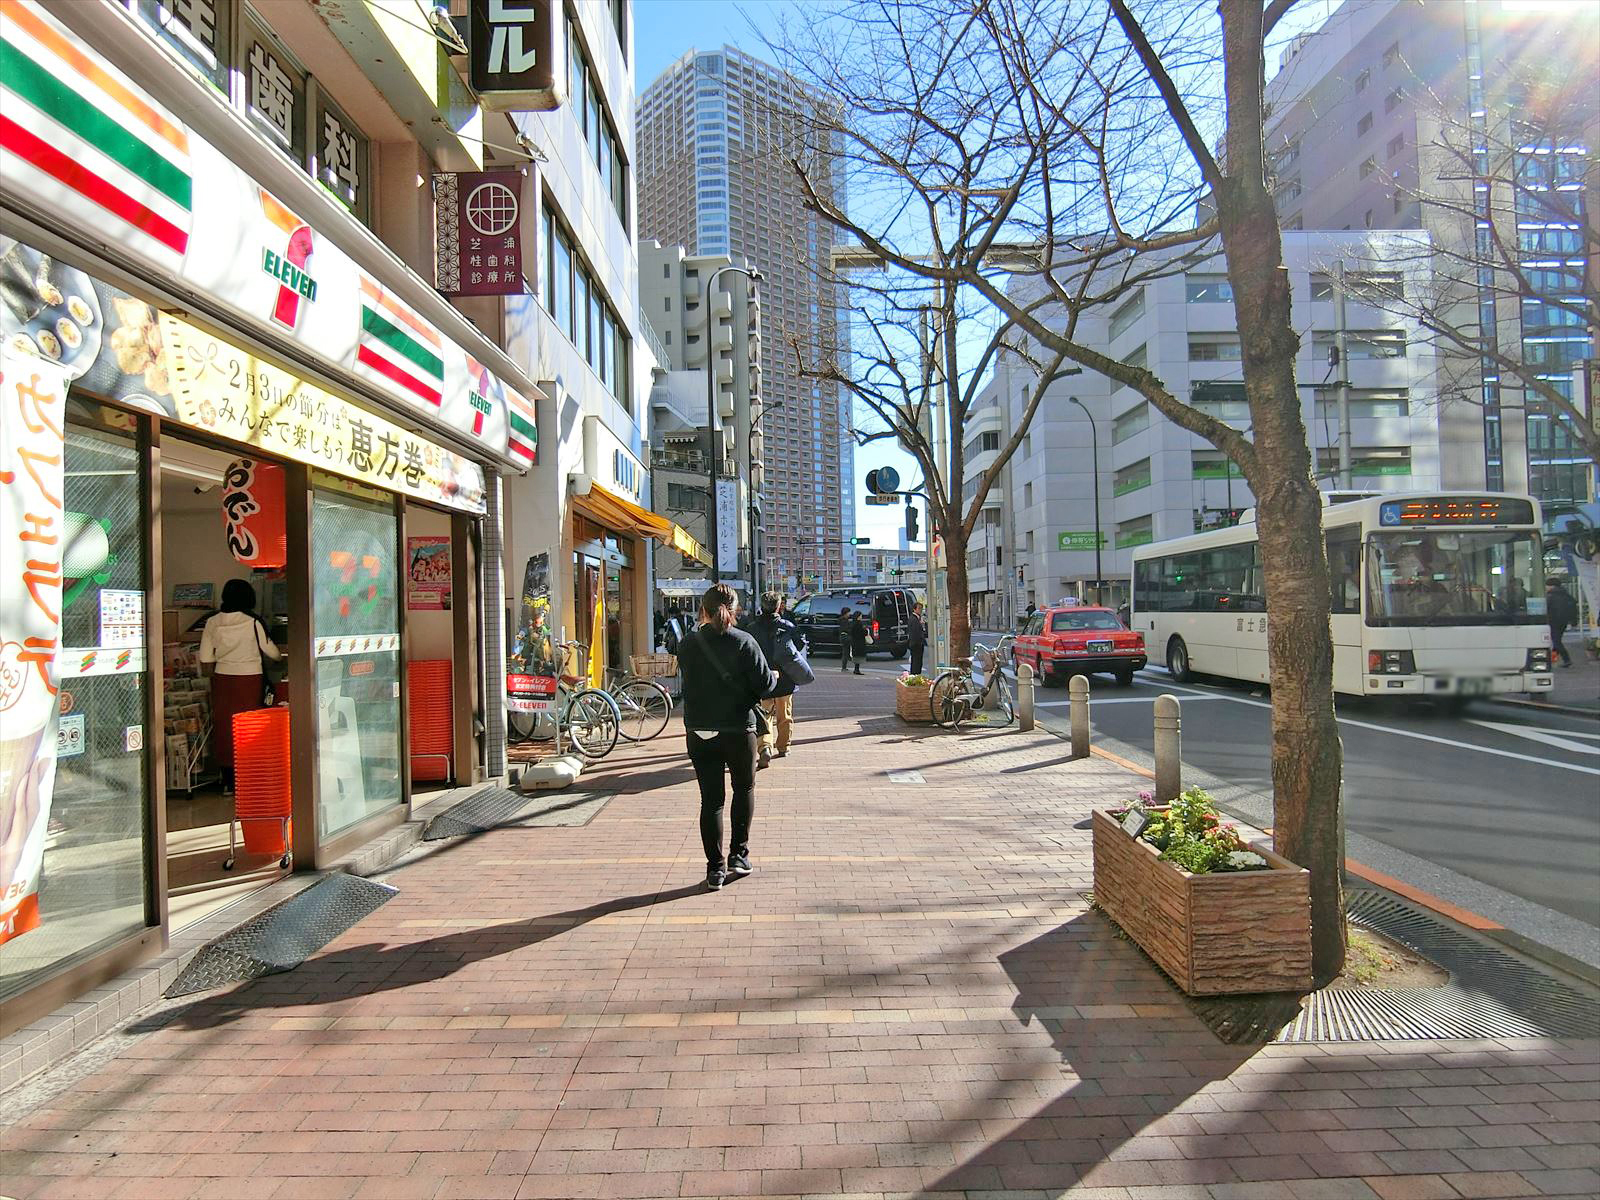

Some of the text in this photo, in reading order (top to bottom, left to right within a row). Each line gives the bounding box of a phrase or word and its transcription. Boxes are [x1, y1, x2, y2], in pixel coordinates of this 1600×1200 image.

[470, 237, 515, 250] 芝浦
[470, 254, 515, 267] 桂歯科
[471, 271, 516, 284] 診療所
[229, 359, 342, 431] 2月3日の節分は
[218, 397, 344, 464] みんなで楽しもう
[347, 418, 426, 489] 恵方巻
[222, 459, 256, 560] おでん
[719, 485, 729, 567] 芝浦ホルモン
